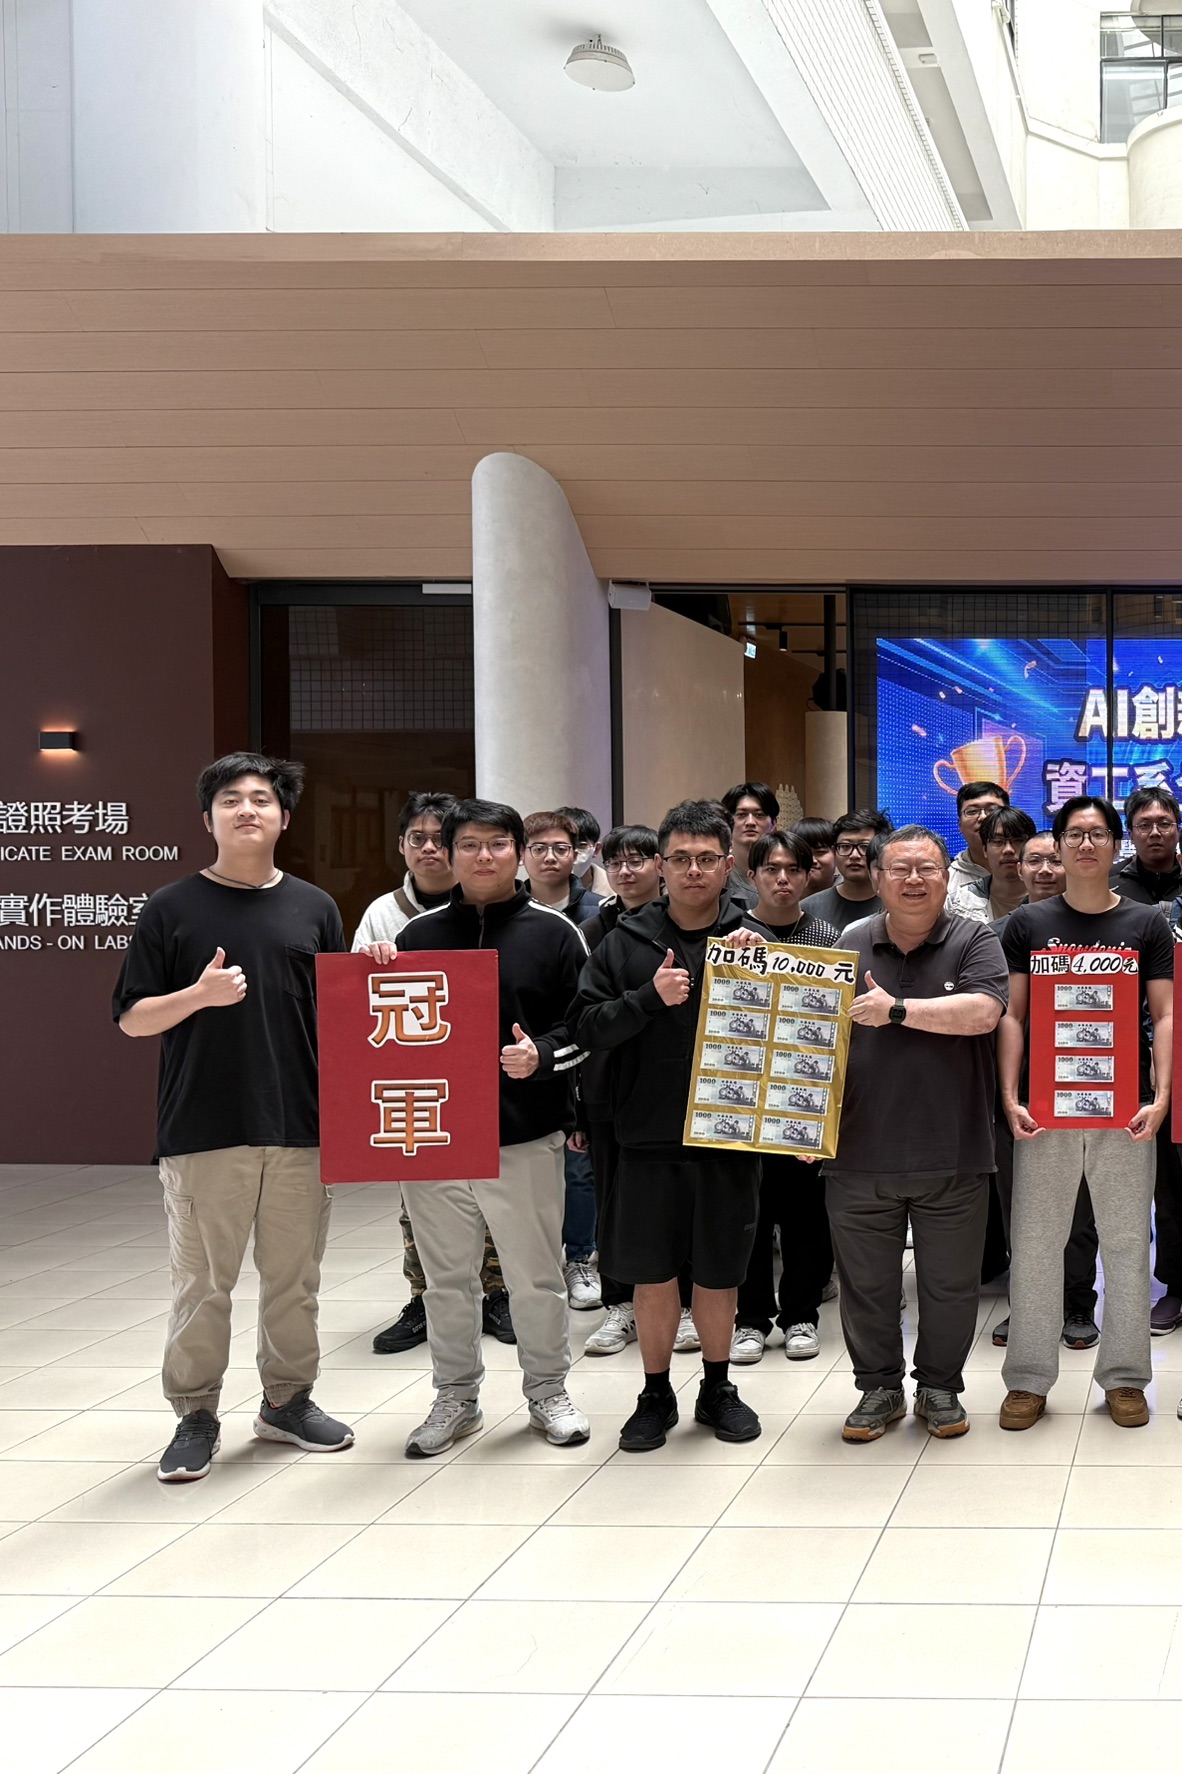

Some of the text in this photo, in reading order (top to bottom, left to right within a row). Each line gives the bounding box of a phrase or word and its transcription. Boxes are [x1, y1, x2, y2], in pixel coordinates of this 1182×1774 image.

[0, 801, 129, 835] 證照考場
[61, 846, 112, 861] EXAM
[122, 846, 178, 861] ROOM
[368, 971, 451, 1156] 冠軍
